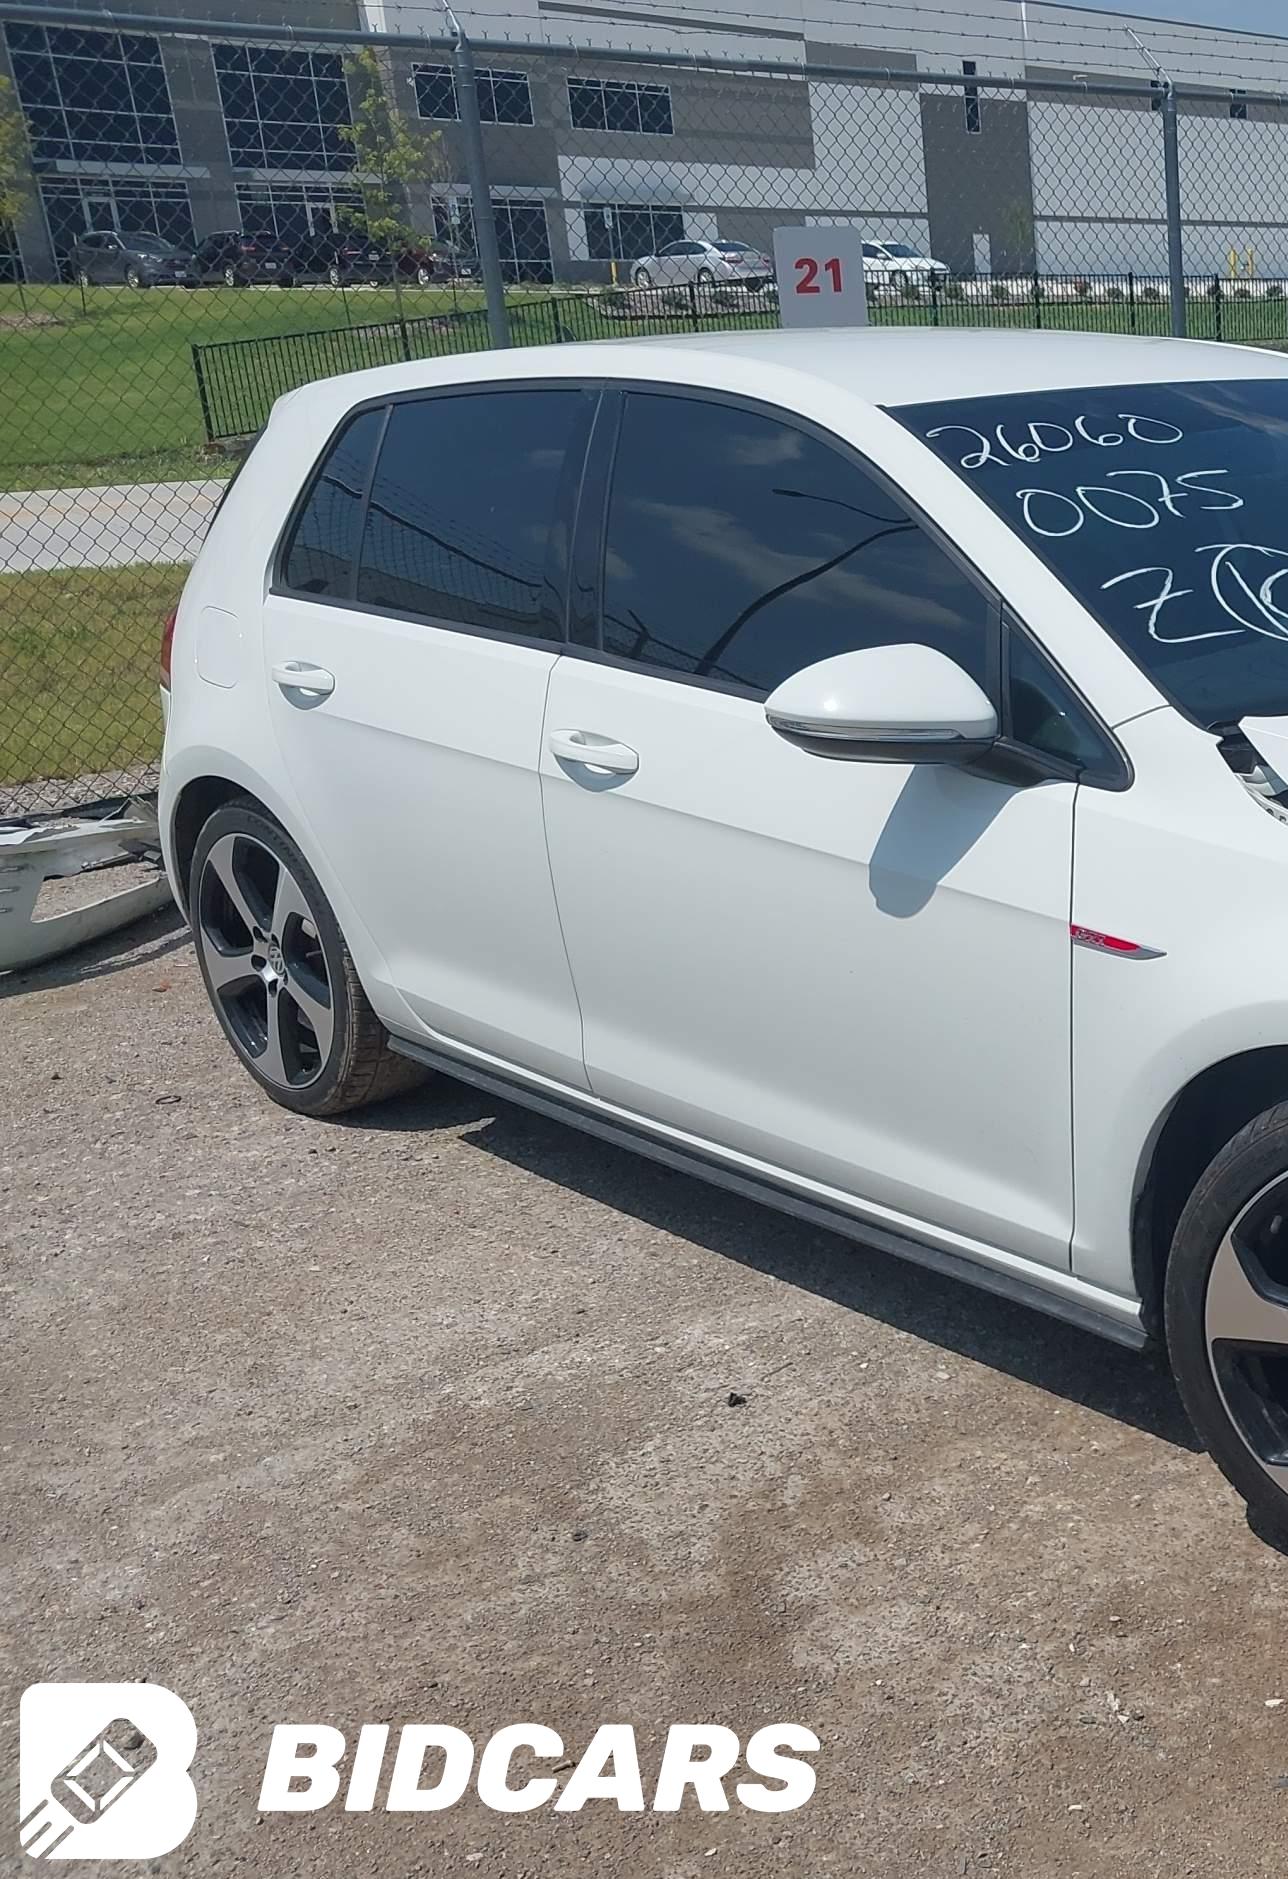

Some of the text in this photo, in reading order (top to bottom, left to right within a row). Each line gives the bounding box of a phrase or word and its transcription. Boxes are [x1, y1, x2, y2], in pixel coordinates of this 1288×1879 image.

[795, 258, 842, 293] 21
[926, 414, 1183, 468] 26060
[1016, 469, 1244, 537] 0075
